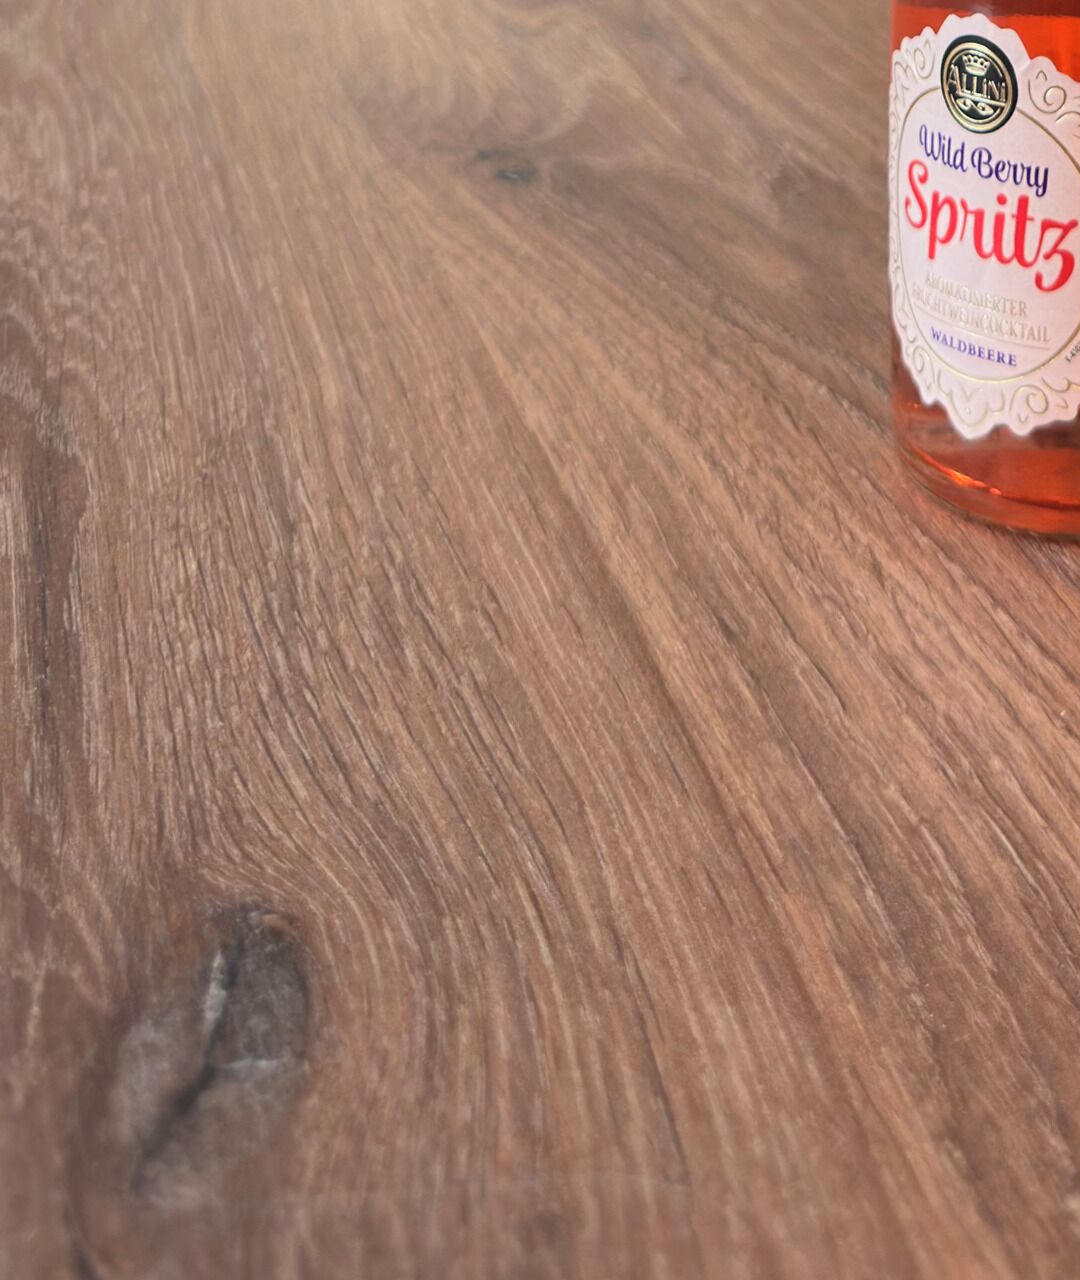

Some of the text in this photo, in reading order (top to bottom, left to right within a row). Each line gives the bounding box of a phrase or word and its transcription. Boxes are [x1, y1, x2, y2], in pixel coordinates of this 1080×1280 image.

[918, 124, 1049, 197] Wild Berry
[904, 159, 1078, 293] Spritz
[930, 326, 1018, 367] WALDBEERE
